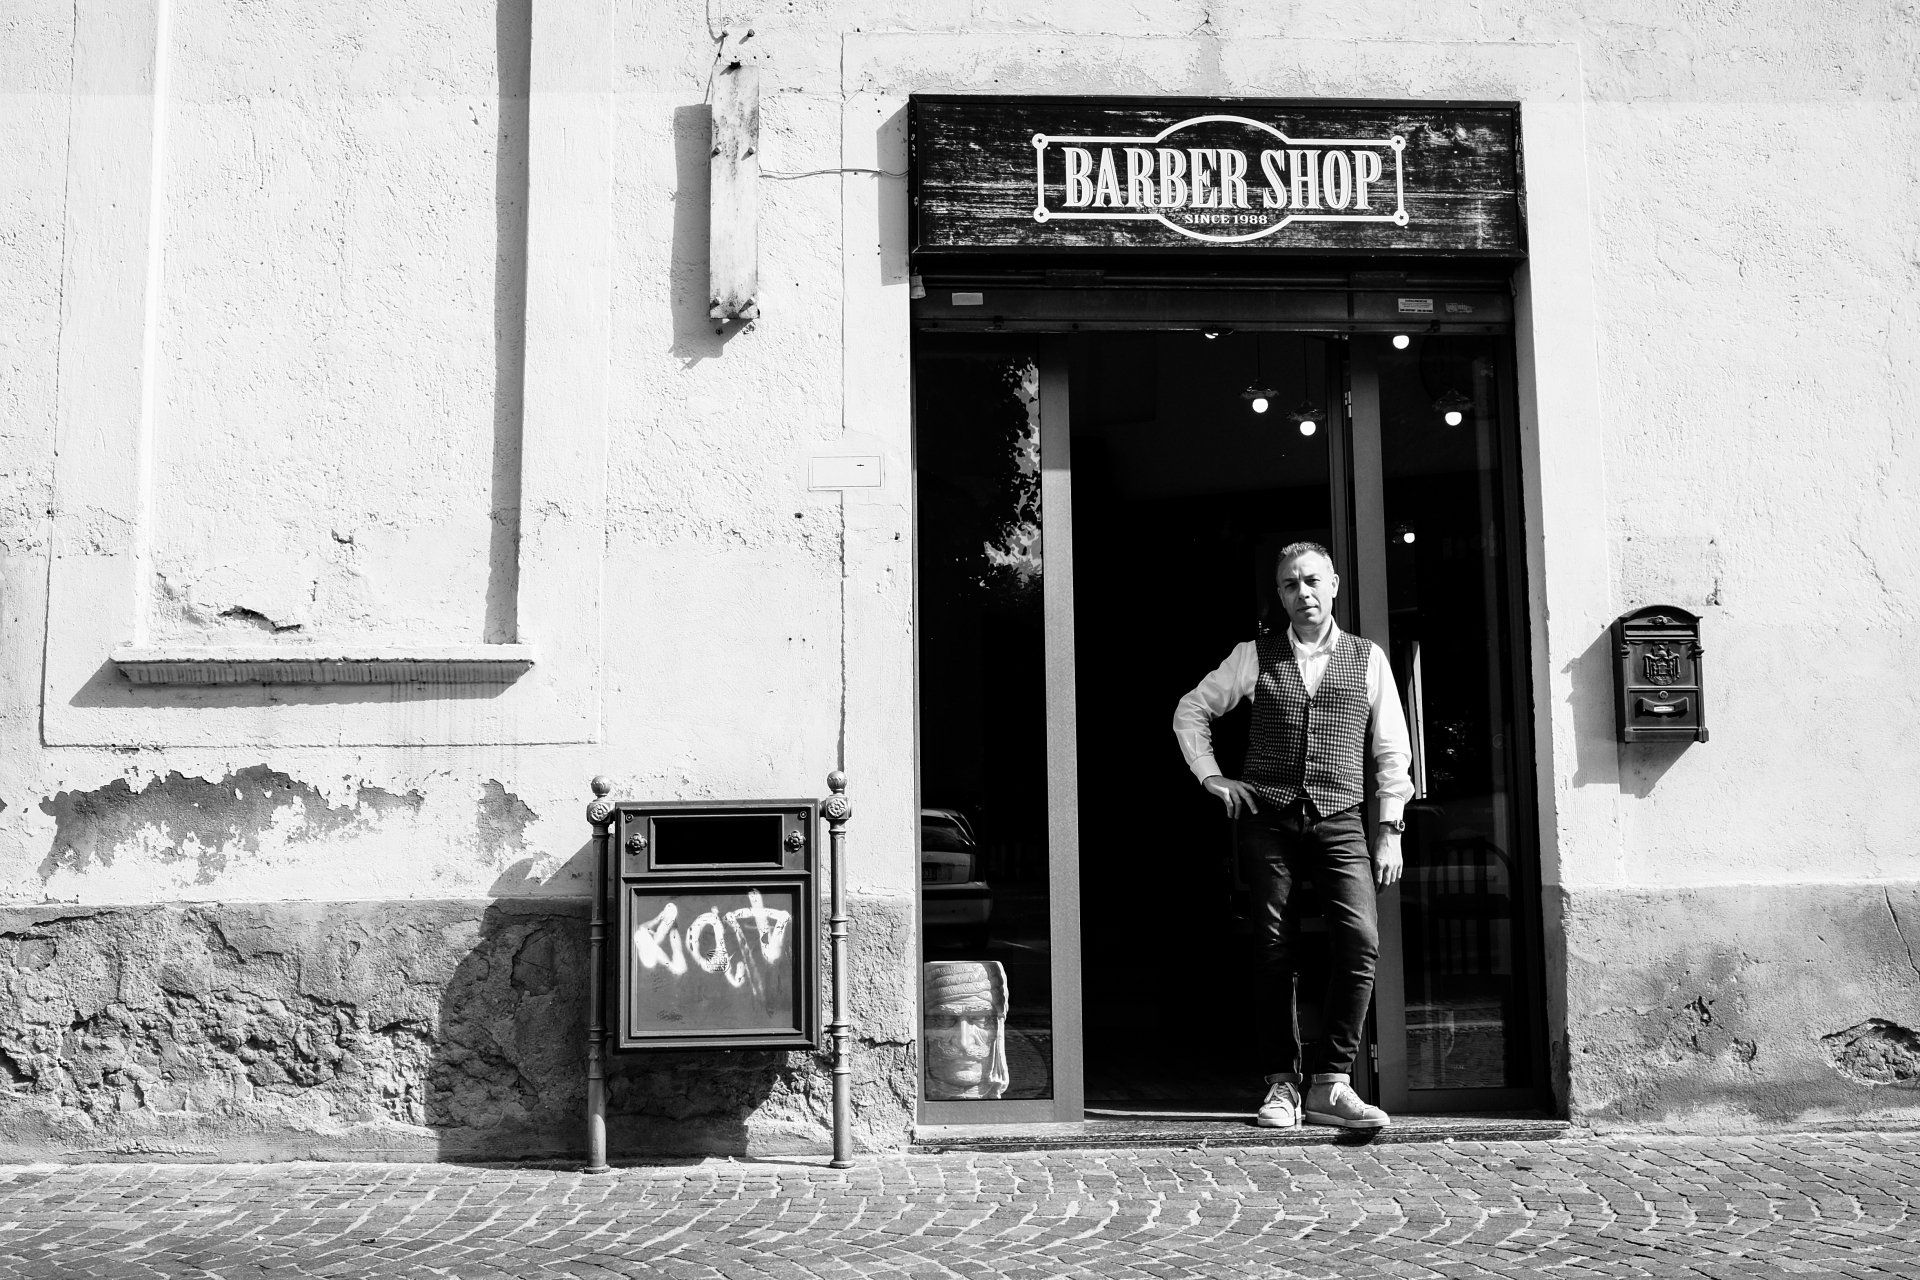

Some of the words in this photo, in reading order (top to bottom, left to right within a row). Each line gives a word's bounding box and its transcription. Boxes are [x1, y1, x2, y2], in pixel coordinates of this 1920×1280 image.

[1061, 147, 1252, 209] BARBER
[1260, 149, 1382, 210] SHOP
[1185, 214, 1230, 224] SINCE
[1233, 214, 1268, 225] 1988
